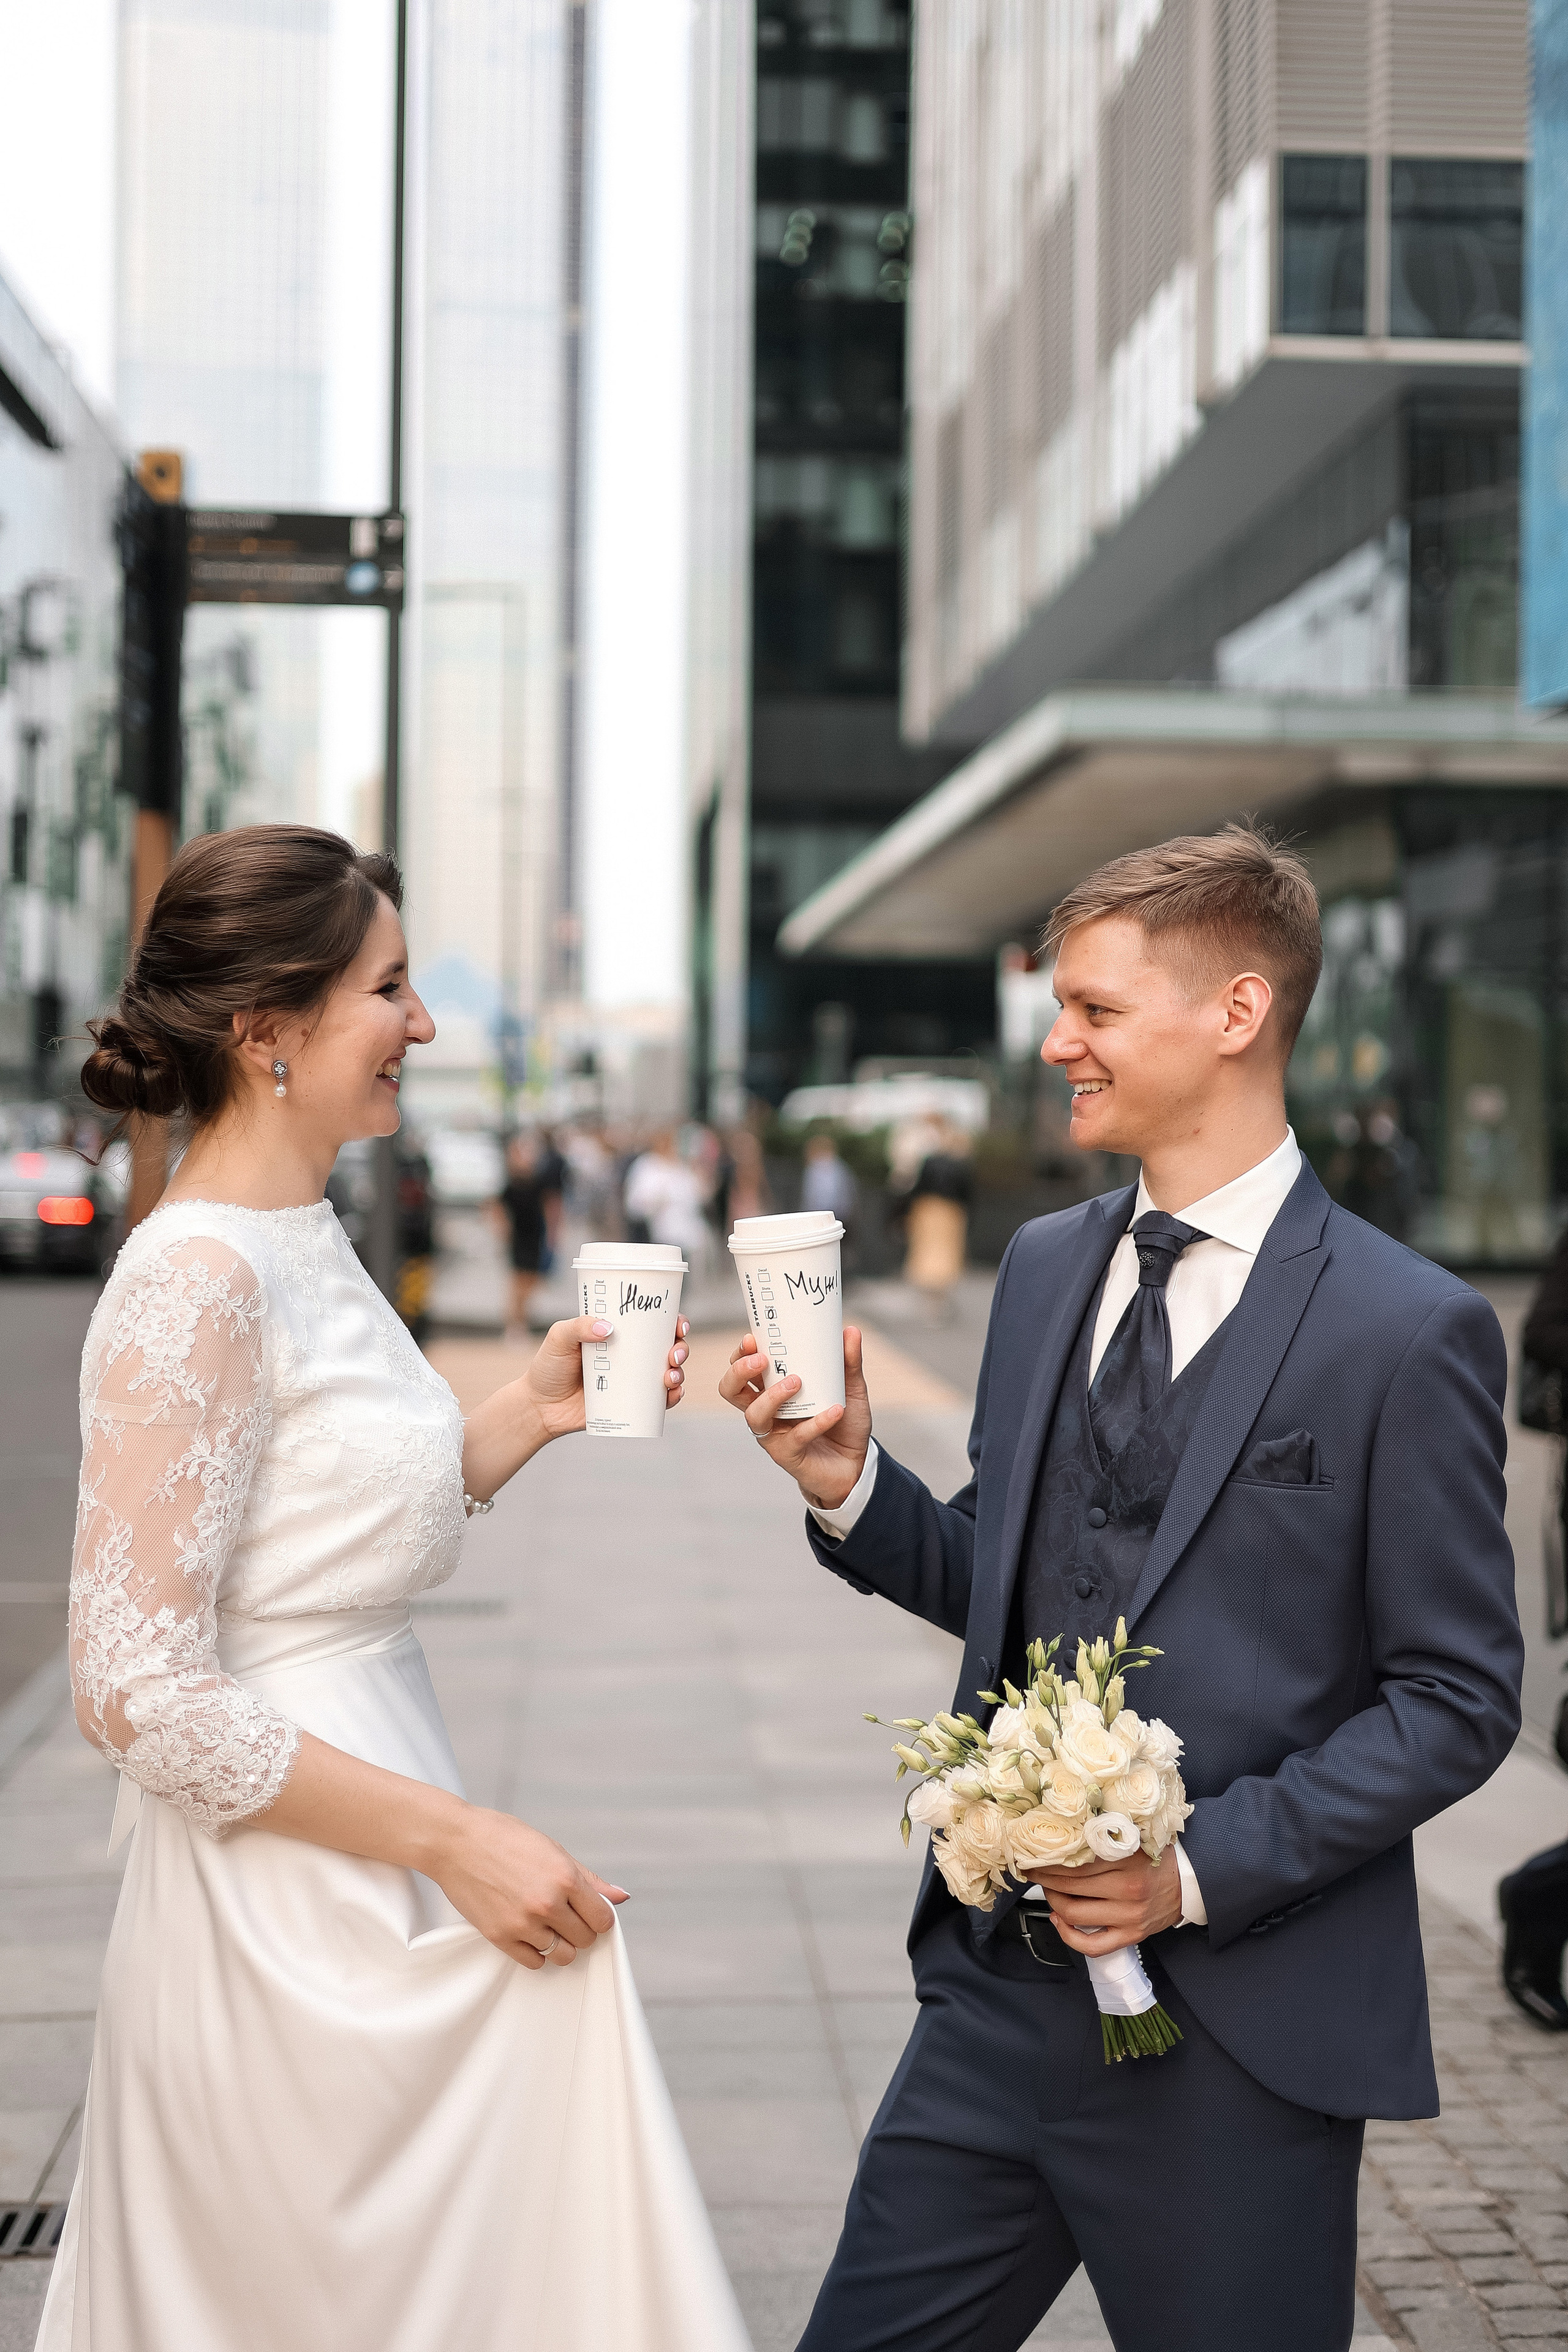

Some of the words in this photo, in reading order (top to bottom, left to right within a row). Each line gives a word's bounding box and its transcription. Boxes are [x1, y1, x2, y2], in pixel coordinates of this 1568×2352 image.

[619, 1281, 669, 1316] Жена!
[745, 1273, 760, 1327] STARBUCKS
[784, 1270, 838, 1305] Муж!
